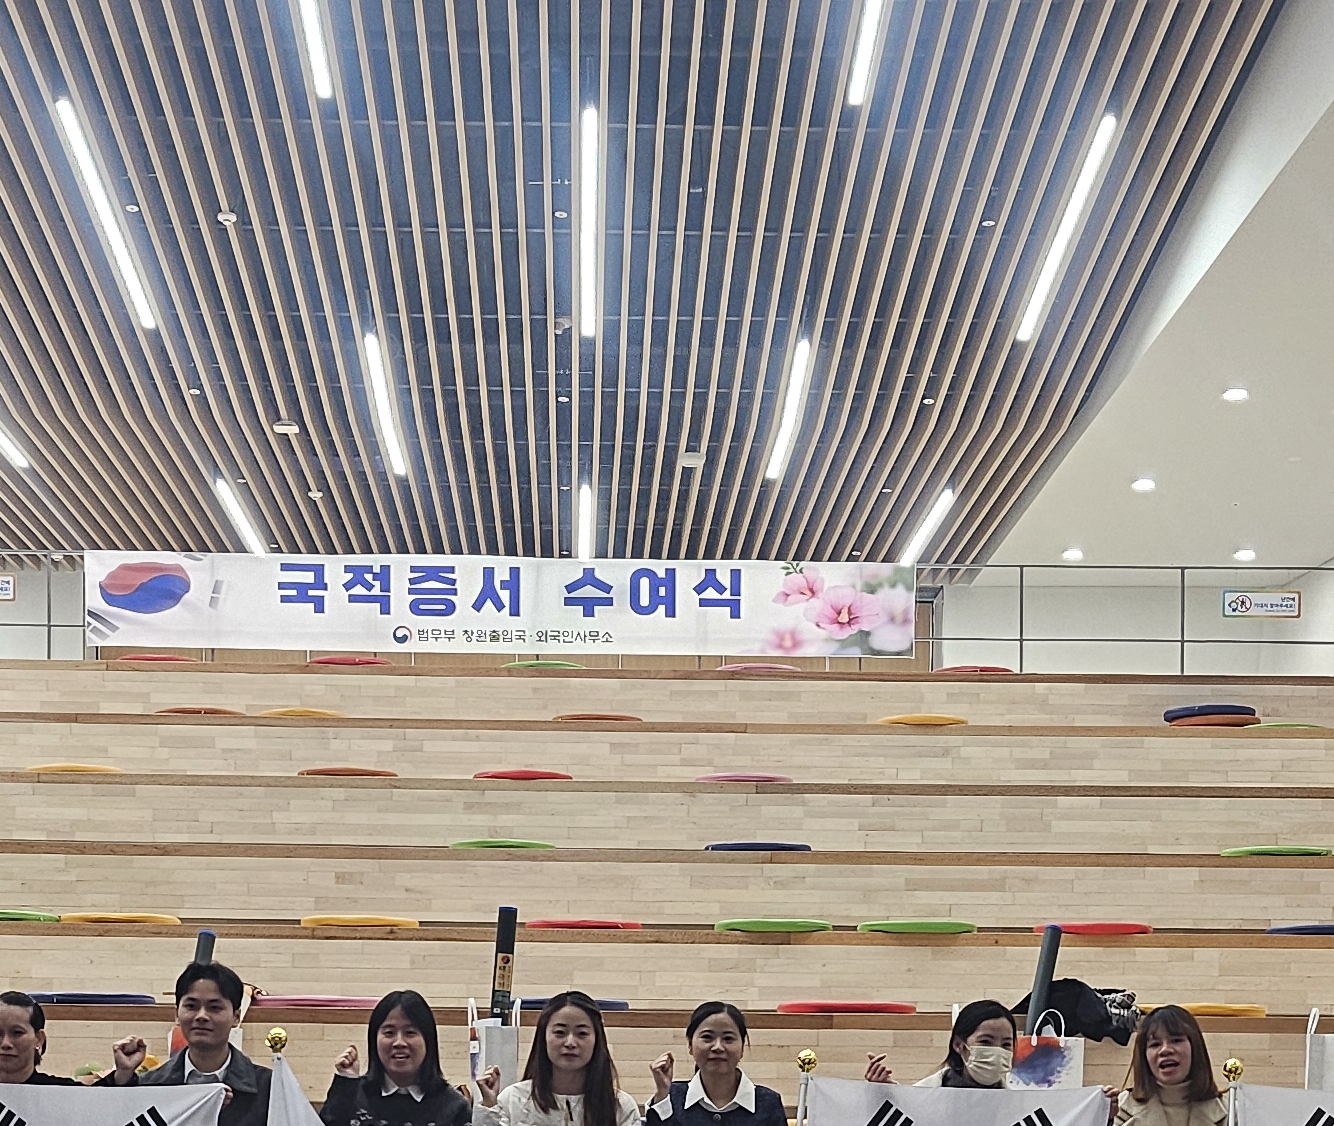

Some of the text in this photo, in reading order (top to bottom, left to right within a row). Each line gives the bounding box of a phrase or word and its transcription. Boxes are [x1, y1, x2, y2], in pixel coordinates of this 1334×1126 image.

[278, 561, 744, 621] 국적증서 수여식
[417, 629, 456, 642] 법무부
